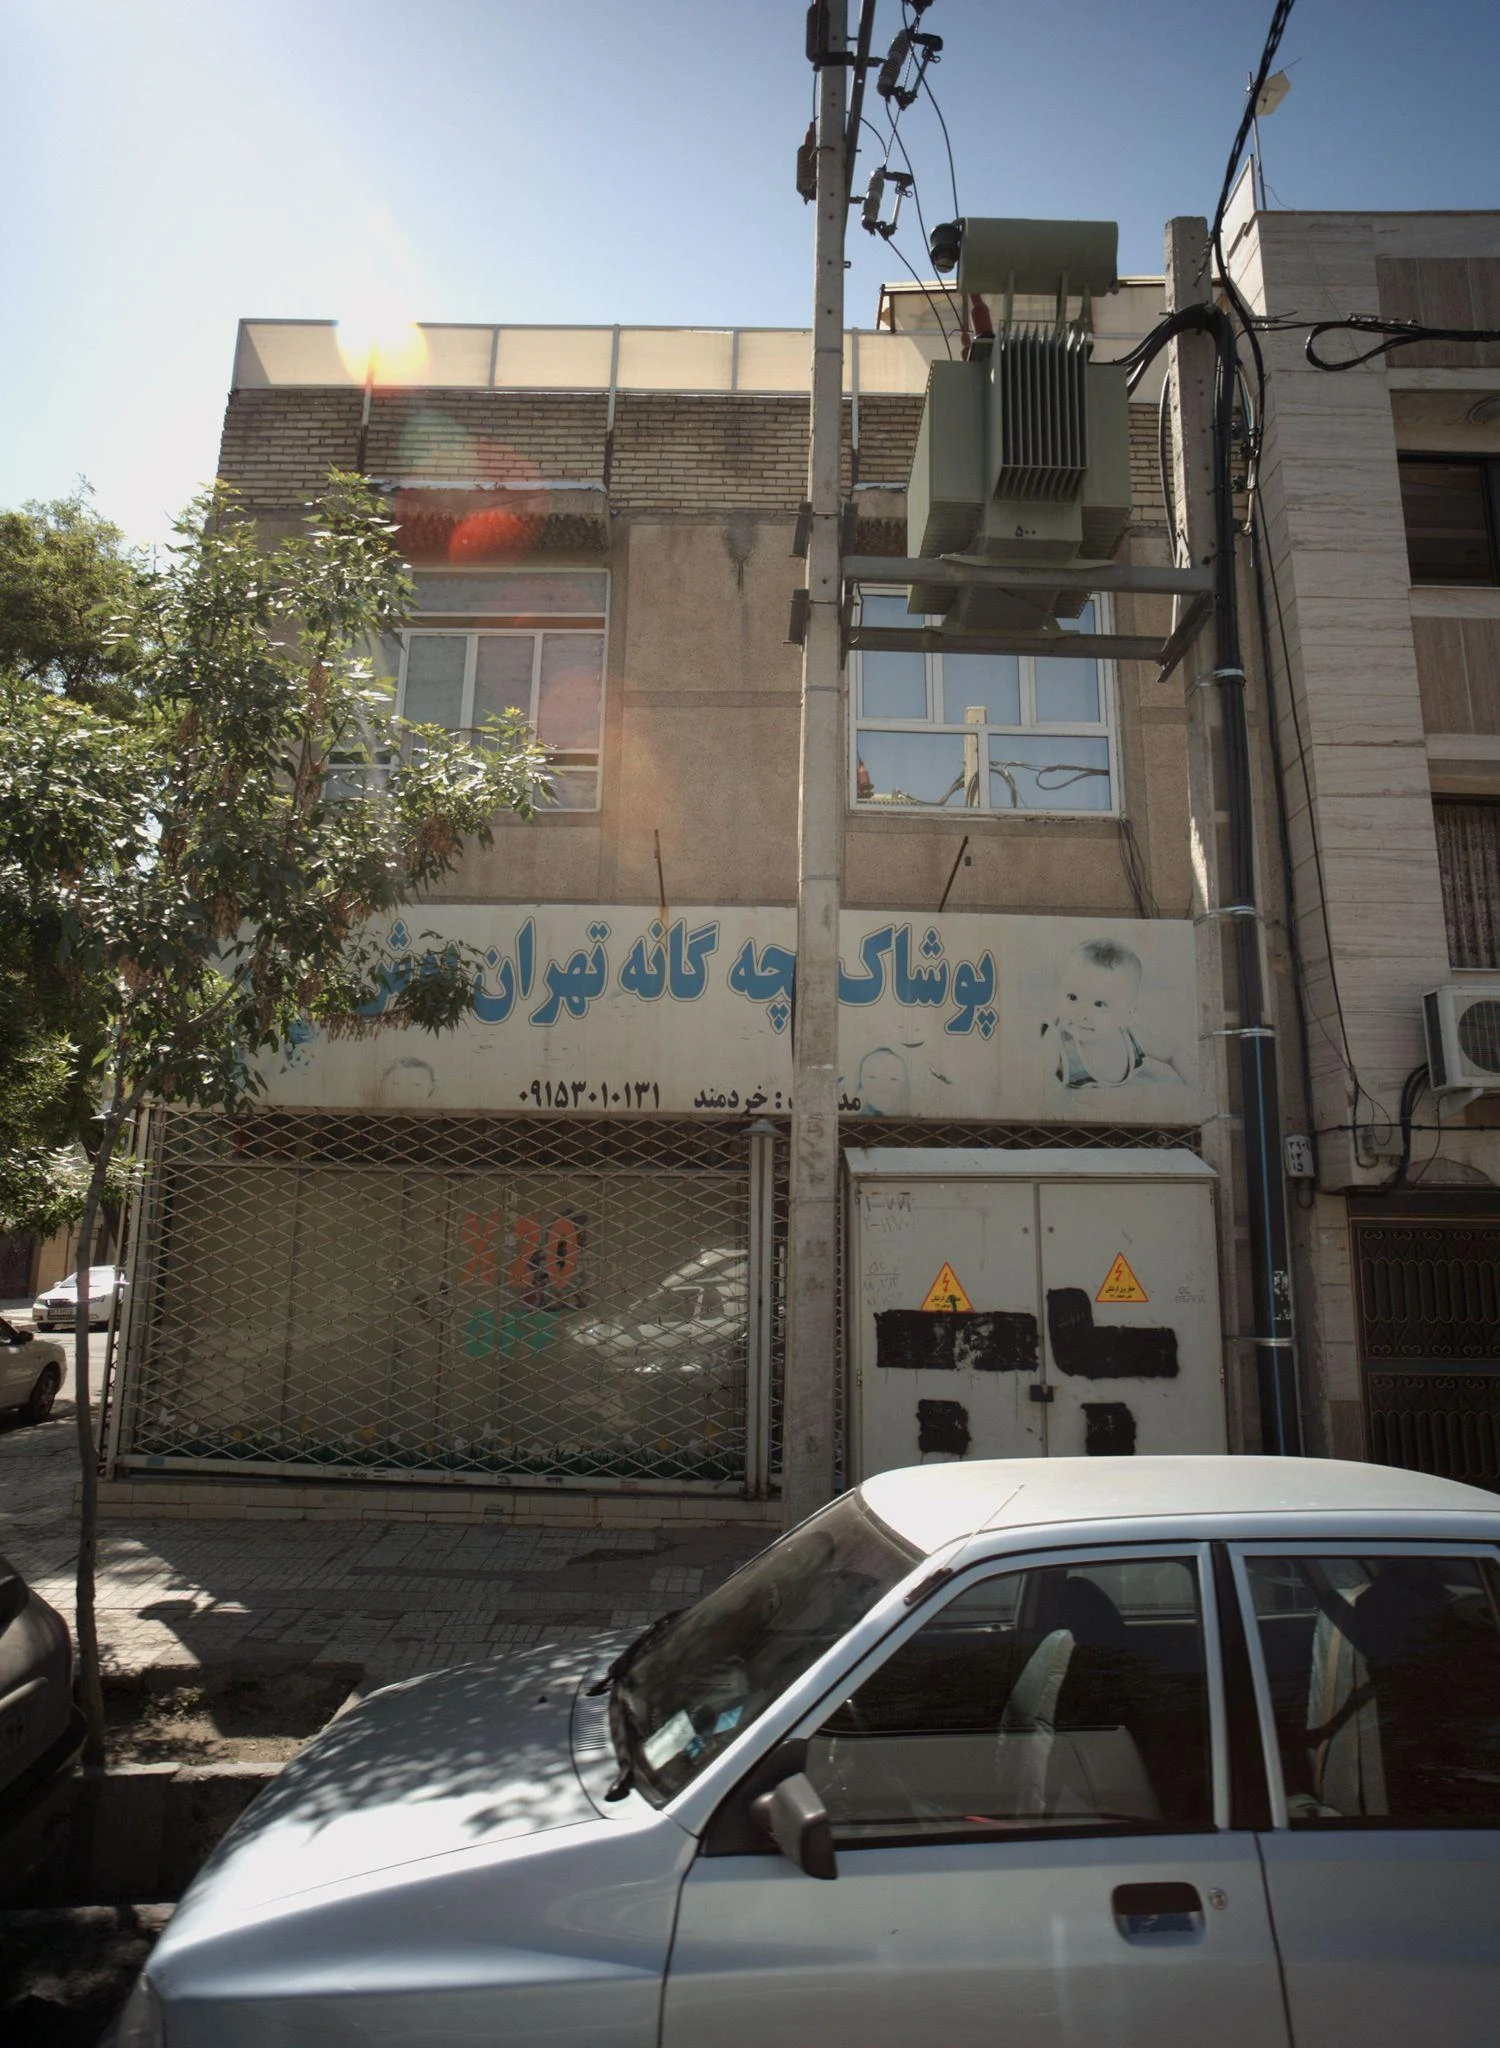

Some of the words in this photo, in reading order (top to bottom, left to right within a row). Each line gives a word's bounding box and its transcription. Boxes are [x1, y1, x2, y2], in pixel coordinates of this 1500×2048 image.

[1014, 524, 1036, 537] ۵۰۰
[473, 916, 610, 1026] تهران
[619, 918, 721, 1001] گانه
[727, 937, 797, 1034] چه
[838, 923, 998, 1040] پوشاک
[518, 1079, 660, 1109] ۰۹۱۵۳۰۱۰۱۳۱
[694, 1085, 768, 1118] خردمند
